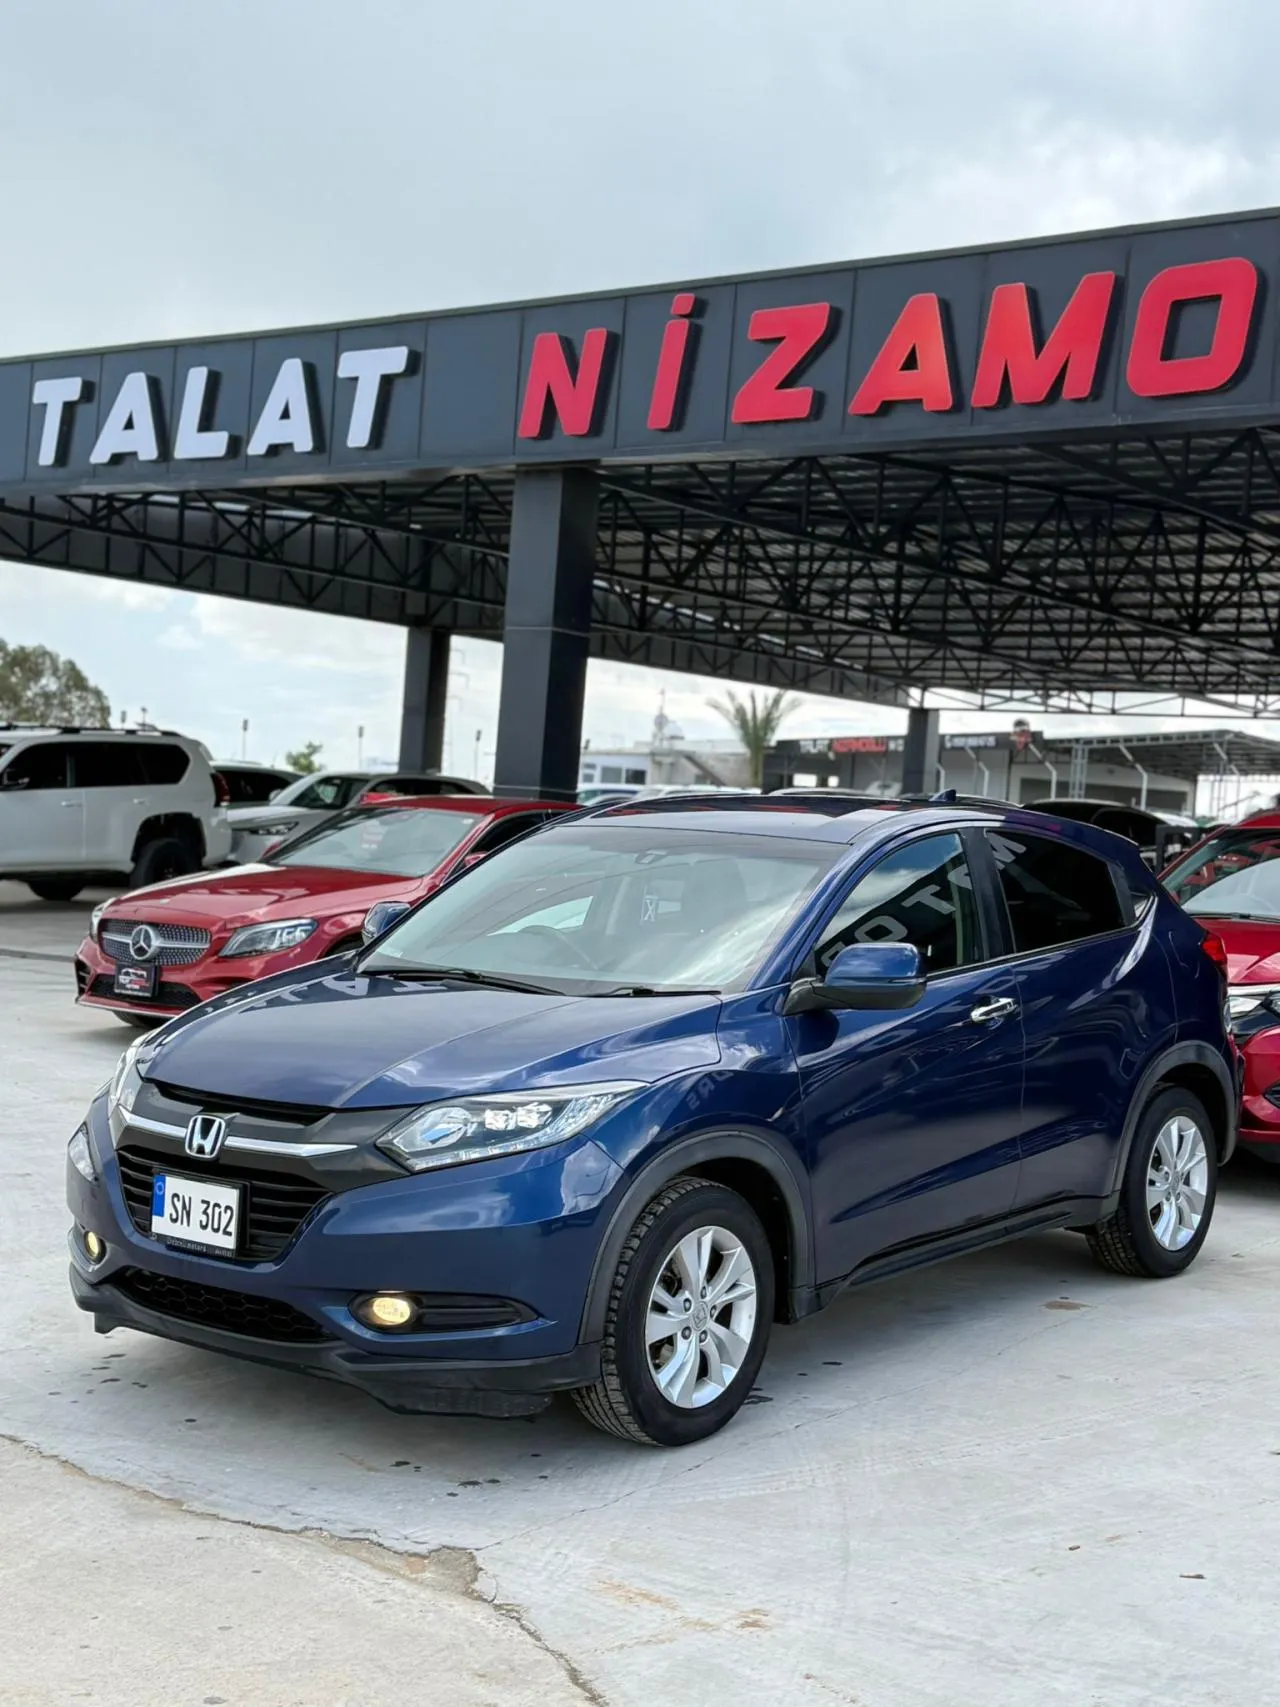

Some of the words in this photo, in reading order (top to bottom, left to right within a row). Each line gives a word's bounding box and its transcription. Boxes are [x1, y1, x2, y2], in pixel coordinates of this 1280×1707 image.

[33, 345, 410, 466] TALAT
[169, 1192, 192, 1228] SN
[199, 1198, 235, 1238] 302
